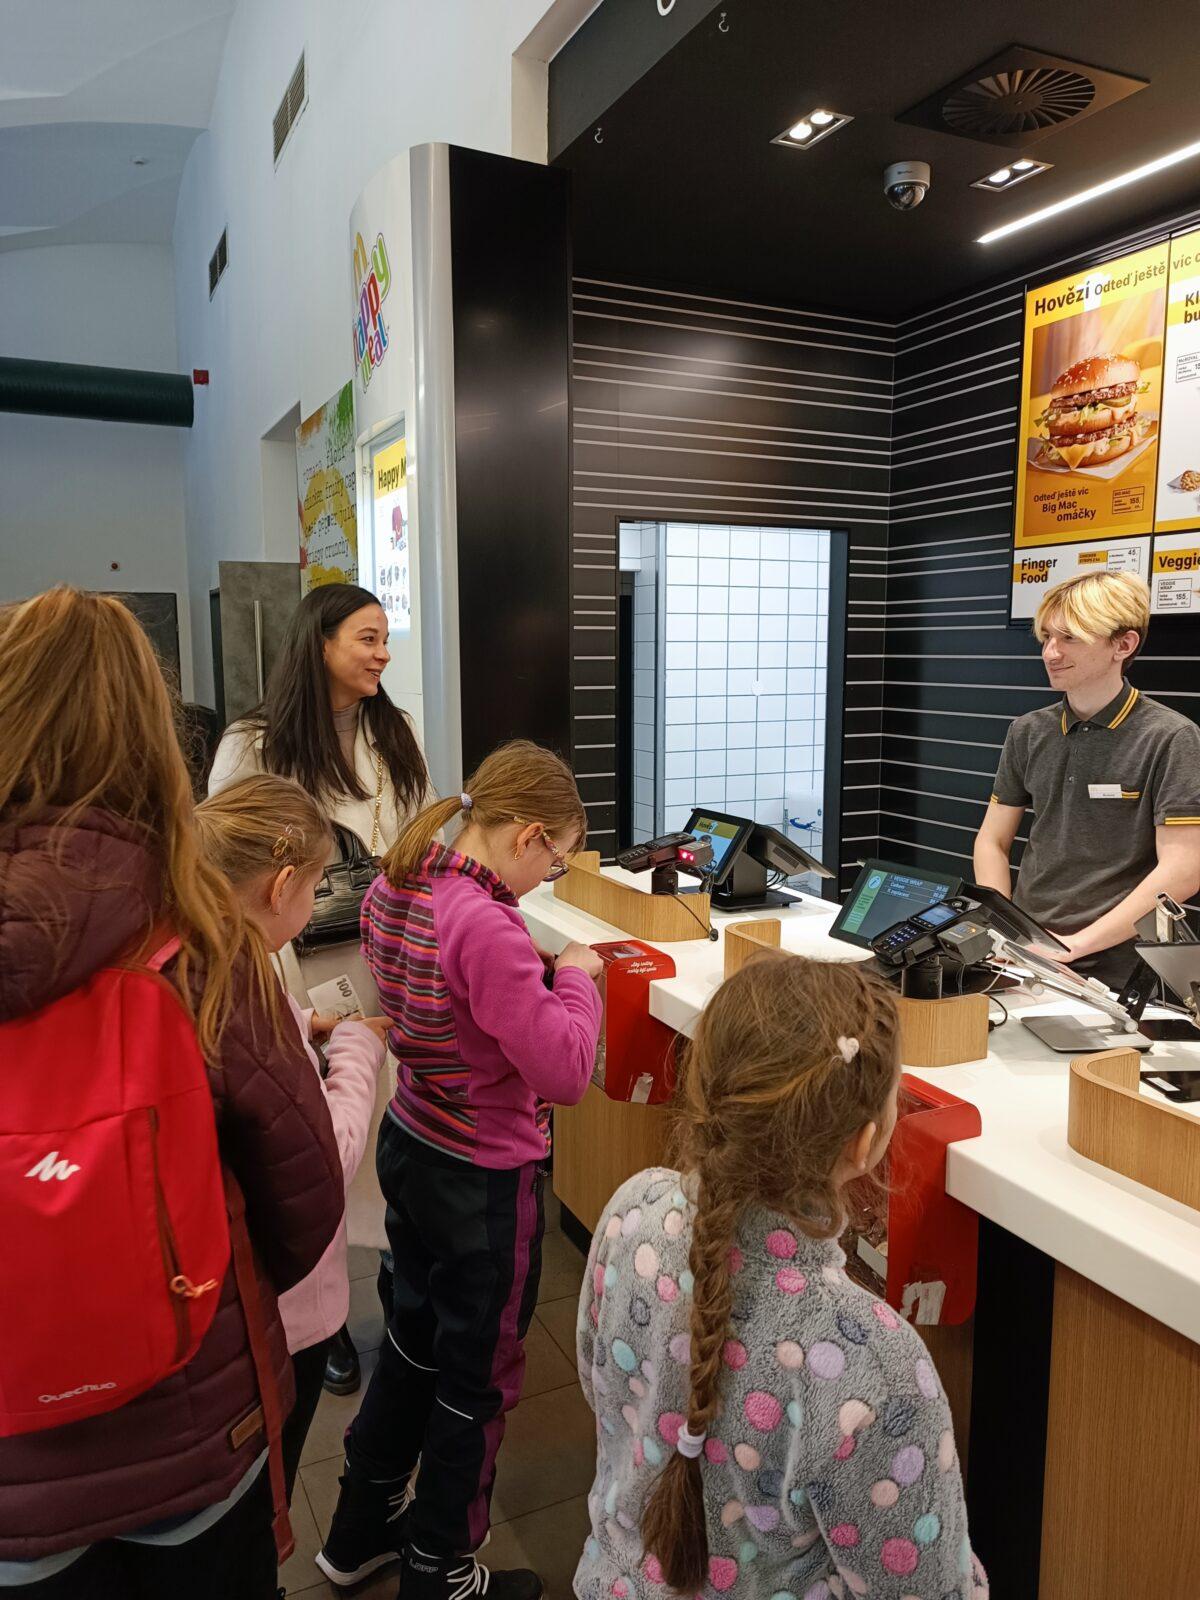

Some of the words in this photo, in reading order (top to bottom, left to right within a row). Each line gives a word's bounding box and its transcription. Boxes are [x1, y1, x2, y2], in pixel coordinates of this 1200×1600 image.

[1034, 281, 1090, 316] Hovězí
[1094, 273, 1133, 295] Odteď
[1133, 262, 1165, 287] ještě
[378, 466, 400, 490] Happy
[1033, 491, 1057, 503] Odteď
[1057, 489, 1077, 501] ještě
[1077, 486, 1089, 495] víc
[1042, 502, 1057, 514] Big
[1058, 500, 1078, 511] Mac
[1056, 508, 1097, 522] omáčky
[1020, 557, 1058, 572] Finger
[1020, 571, 1049, 584] Food
[336, 977, 353, 998] 100
[38, 1381, 117, 1403] Quechua
